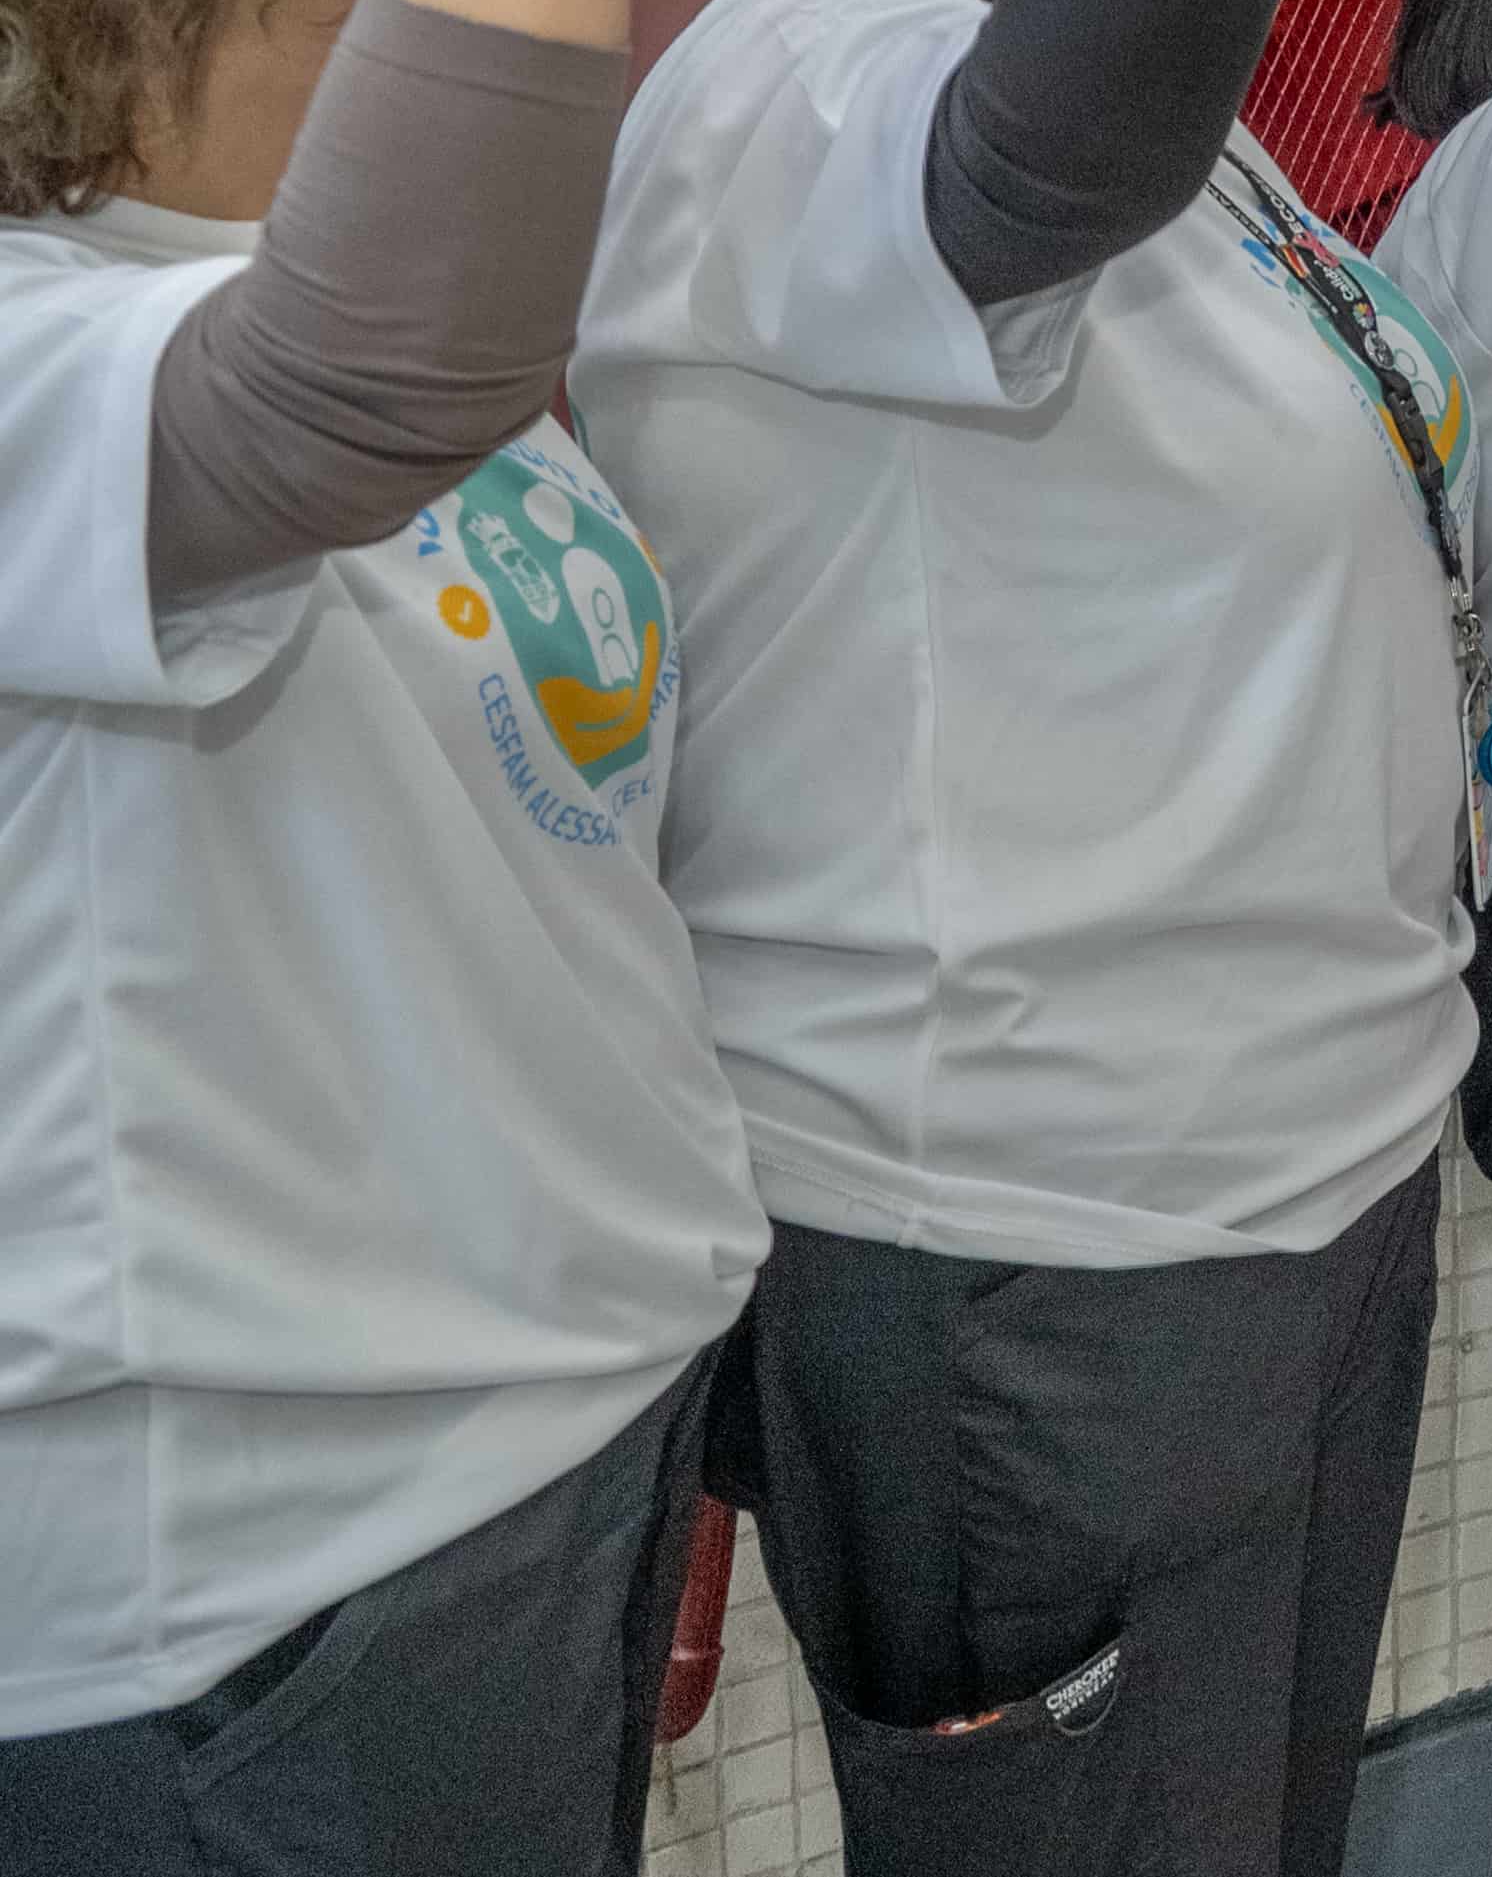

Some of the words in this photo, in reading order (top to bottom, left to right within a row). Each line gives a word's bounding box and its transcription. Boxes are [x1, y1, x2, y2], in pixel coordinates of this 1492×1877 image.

[478, 673, 529, 800] CESFAM
[526, 789, 622, 846] ALESSA
[1046, 1649, 1119, 1711] CHEROKEE
